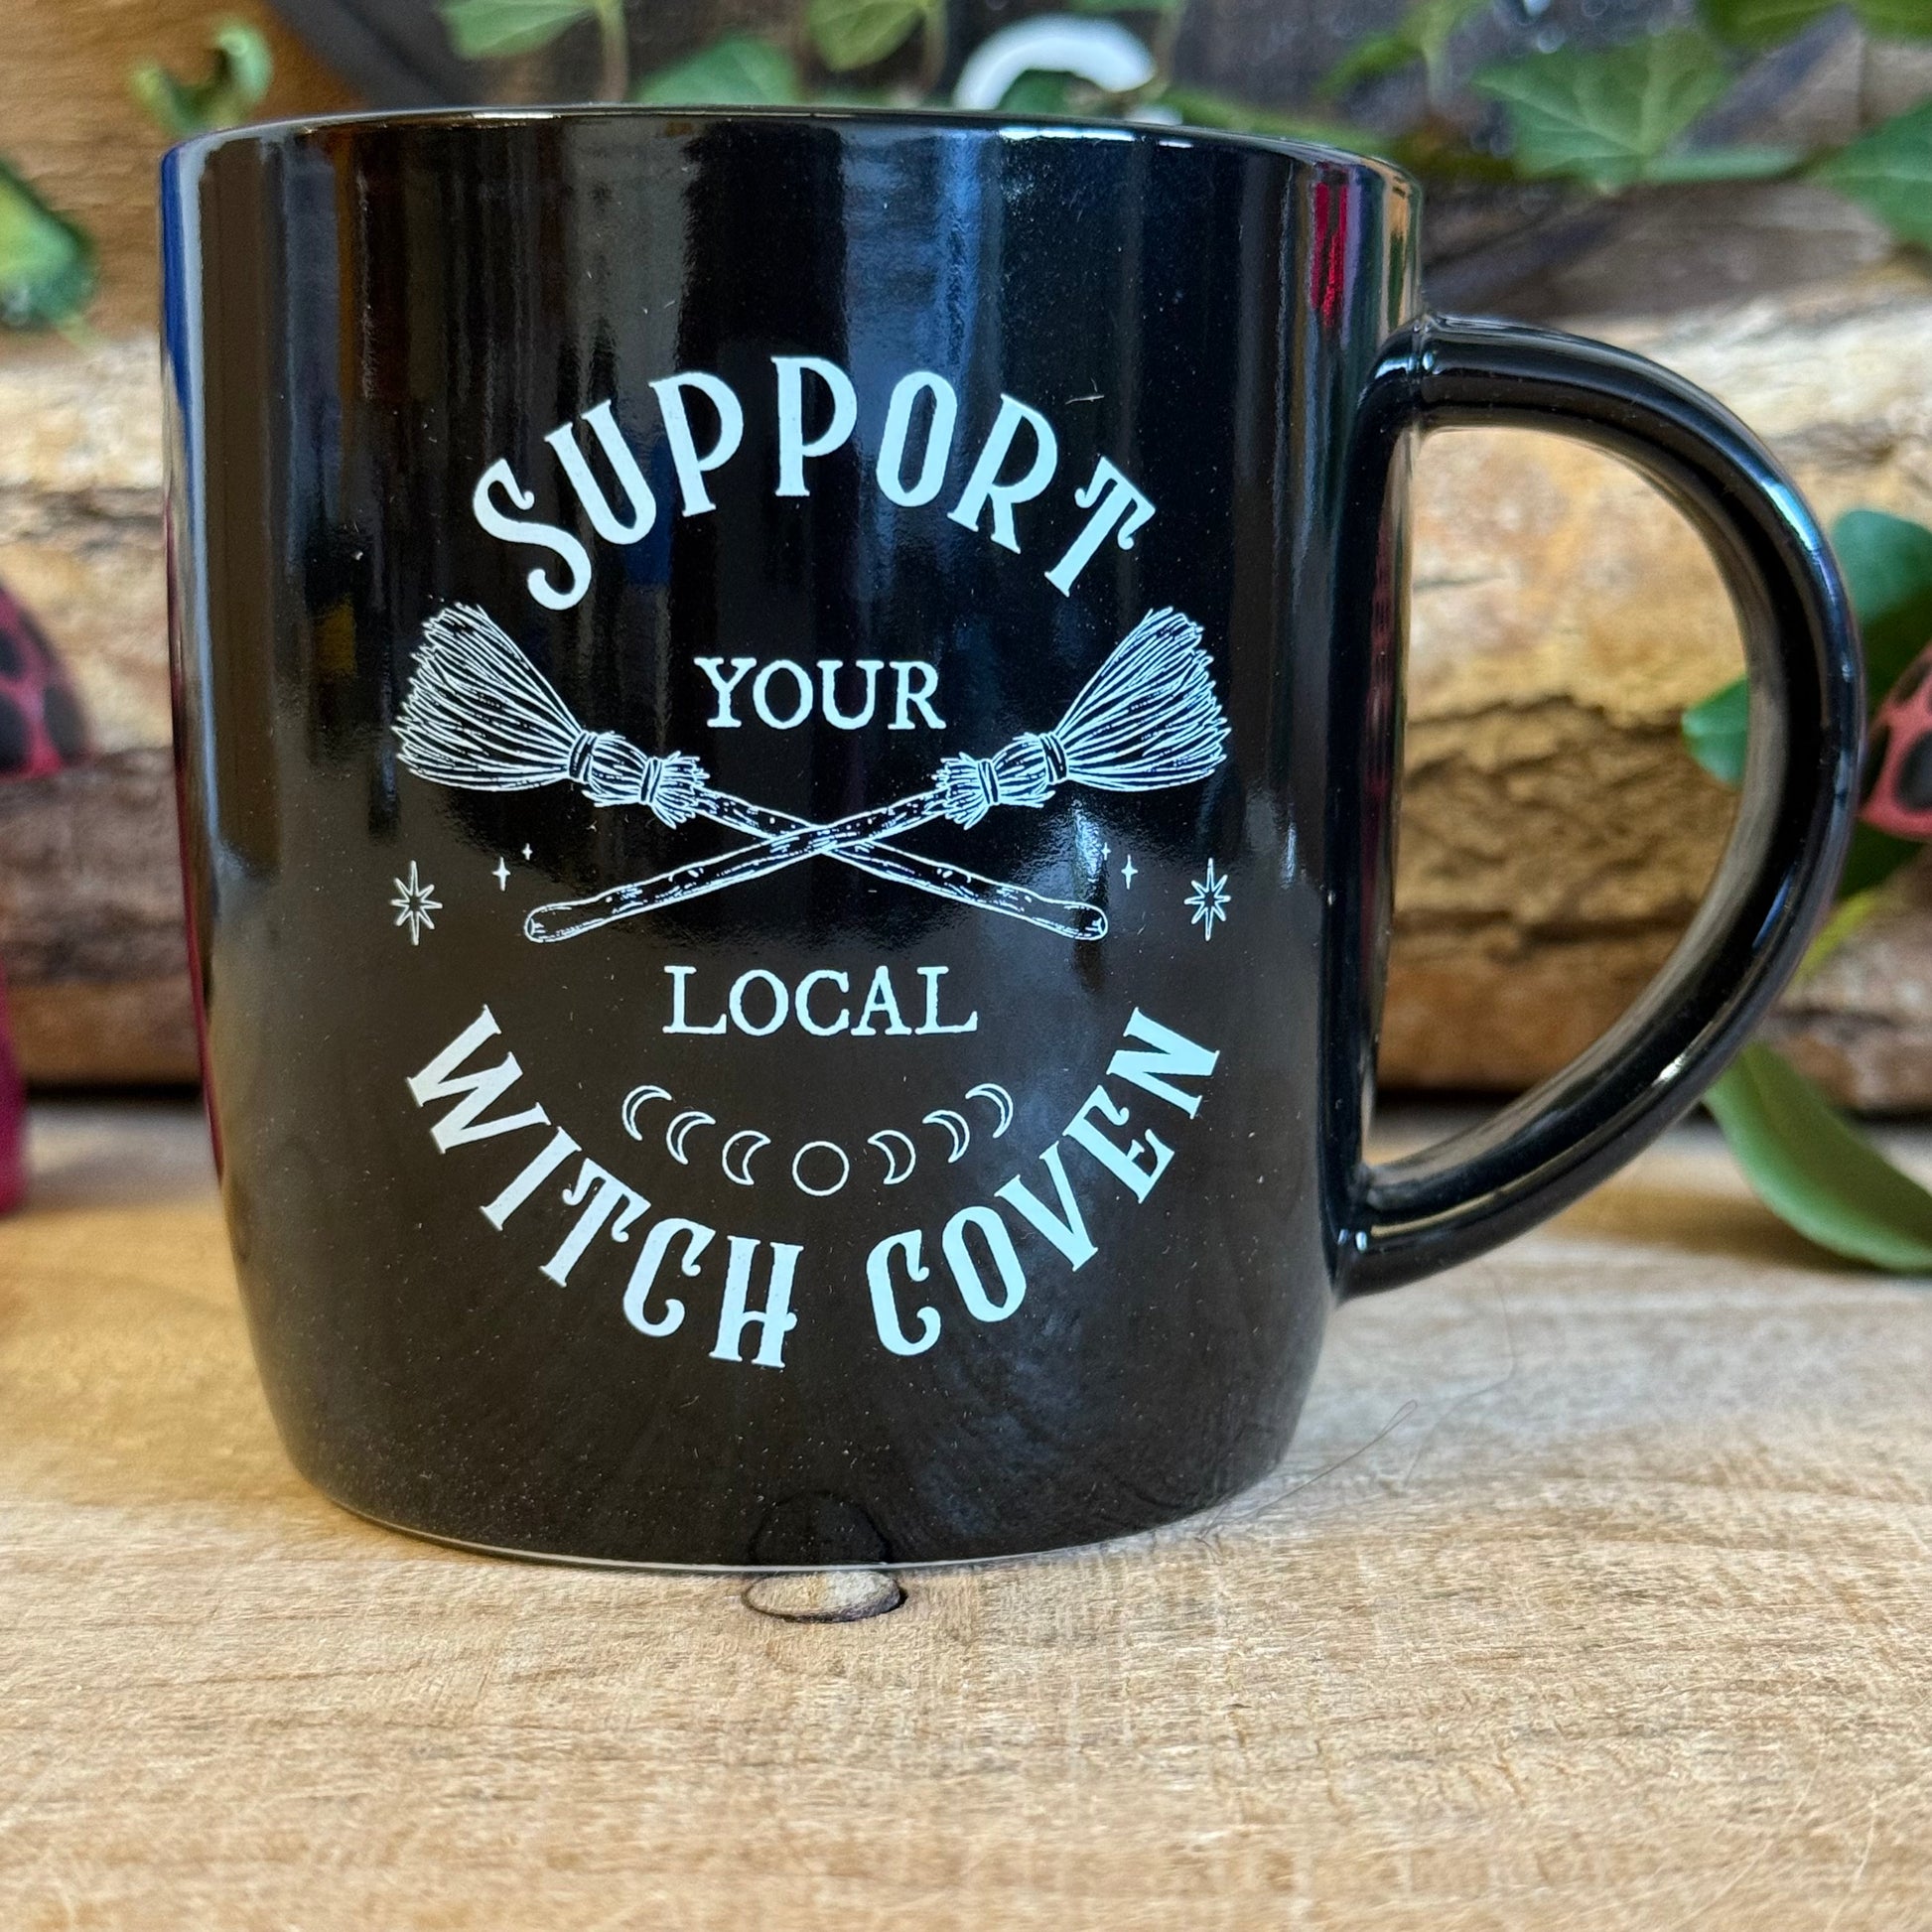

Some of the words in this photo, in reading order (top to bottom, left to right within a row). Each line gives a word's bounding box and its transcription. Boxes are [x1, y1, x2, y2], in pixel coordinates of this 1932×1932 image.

[474, 356, 1155, 611] SUPPORT
[694, 657, 947, 731] YOUR
[662, 965, 978, 1036] LOCAL
[407, 1005, 803, 1368] WITCH
[866, 1007, 1219, 1356] COVEN
